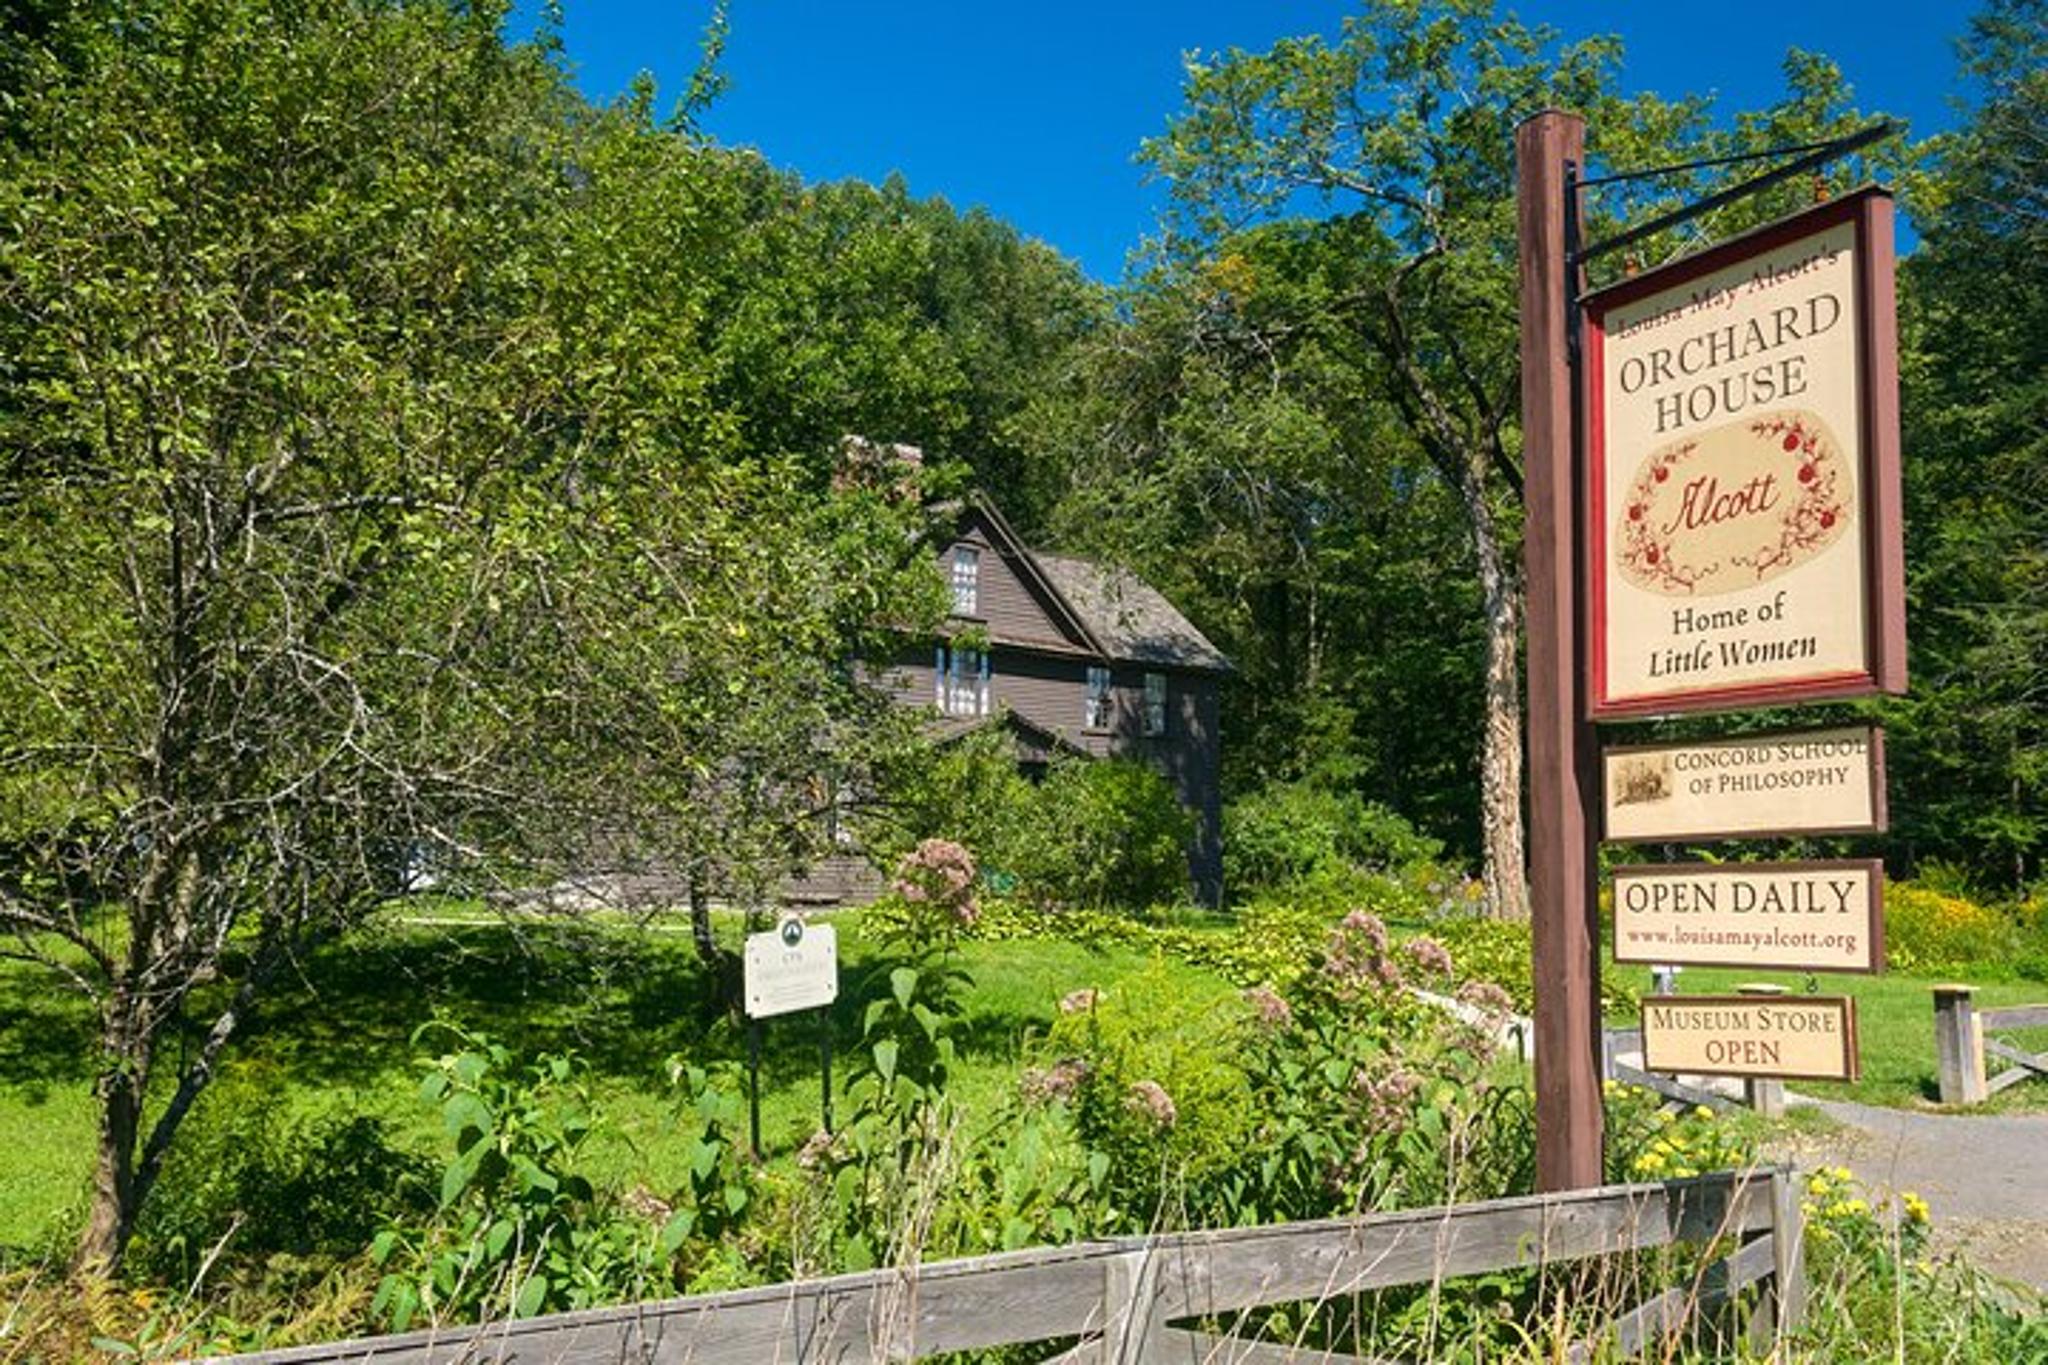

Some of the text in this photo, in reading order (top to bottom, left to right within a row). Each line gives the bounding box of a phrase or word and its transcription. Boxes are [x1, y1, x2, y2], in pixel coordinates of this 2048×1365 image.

[1617, 245, 1839, 339] Louisa May Alcott's
[1620, 293, 1841, 393] ORCHARD
[1655, 355, 1808, 433] HOUSE
[1661, 474, 1781, 535] Alcott
[1673, 591, 1787, 634] Home of
[1649, 637, 1817, 677] Little Women
[1674, 738, 1868, 771] CONCORD SCHOOL
[1689, 767, 1850, 795] OF PHILOSOPHY
[1626, 881, 1856, 914] OPEN DAILY
[1627, 925, 1857, 954] www.louisamayalcott.org
[1653, 1006, 1836, 1033] MUSEUM STORE
[1706, 1040, 1781, 1065] OPEN
